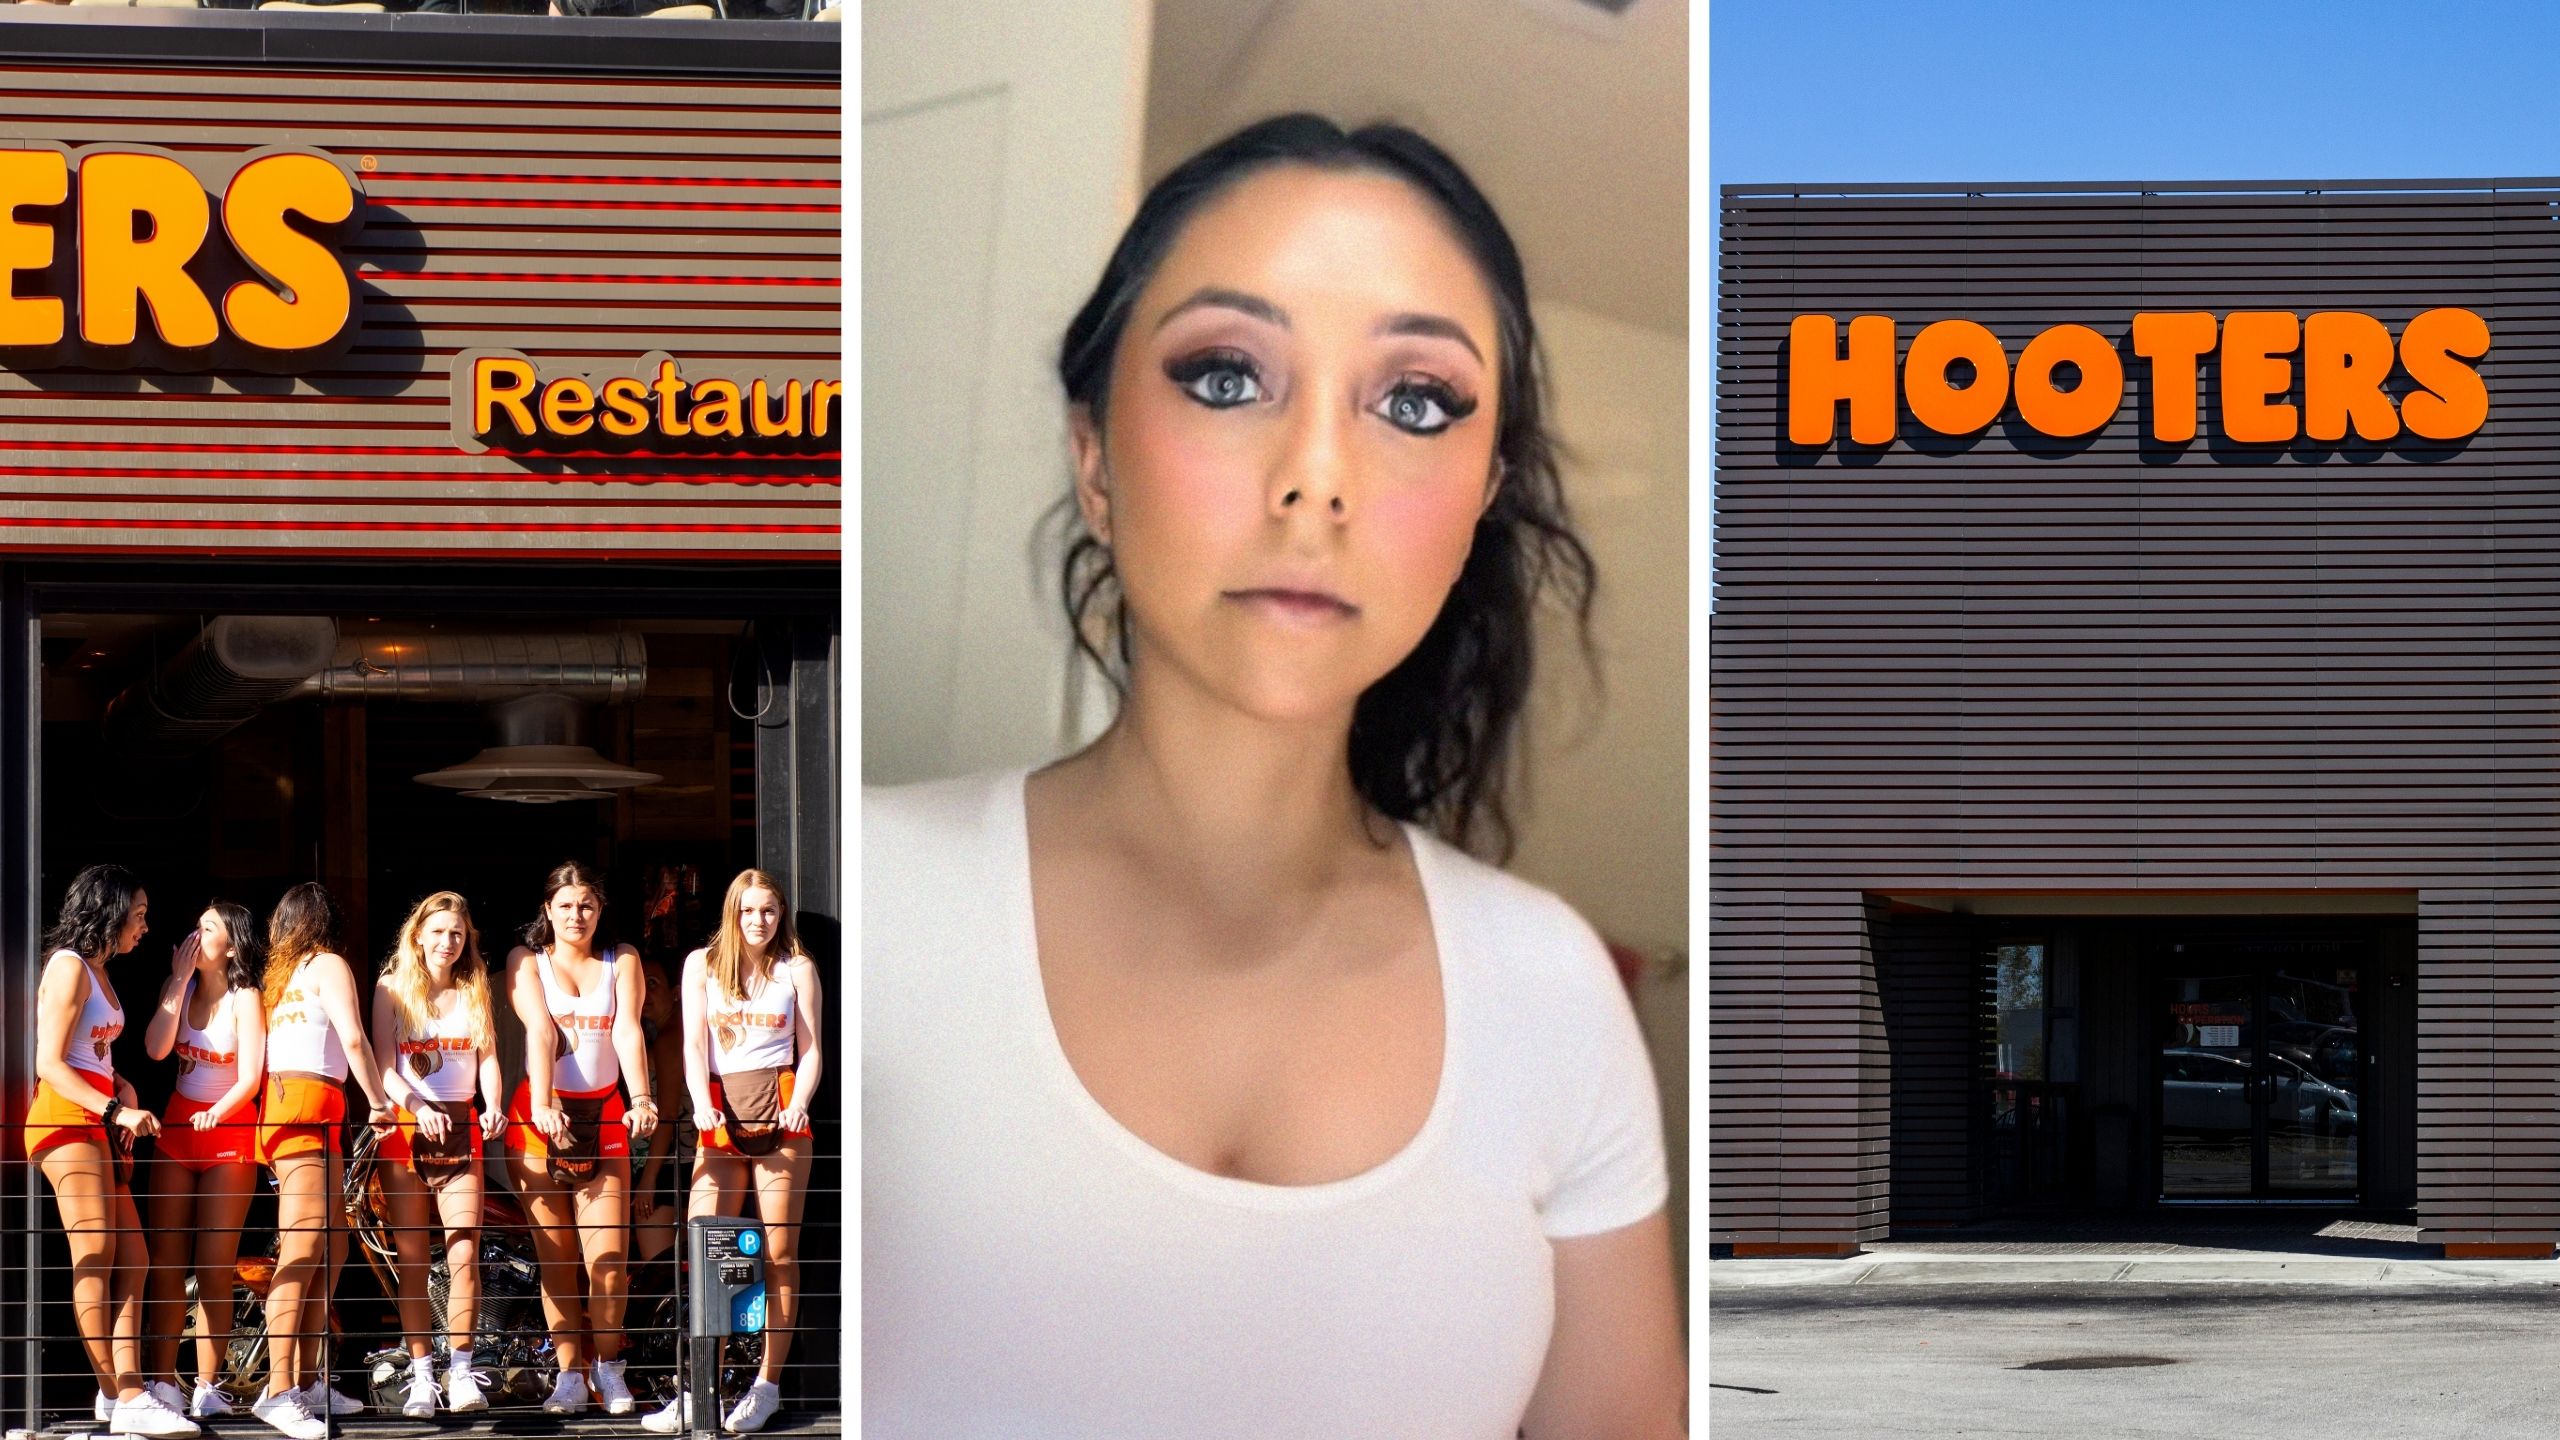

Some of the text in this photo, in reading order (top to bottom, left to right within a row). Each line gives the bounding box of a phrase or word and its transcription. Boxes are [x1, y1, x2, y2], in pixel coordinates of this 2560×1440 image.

[0, 149, 353, 350] ERS
[473, 358, 841, 437] Restaur
[1789, 308, 2491, 445] HOOTERS
[740, 1313, 761, 1327] 851
